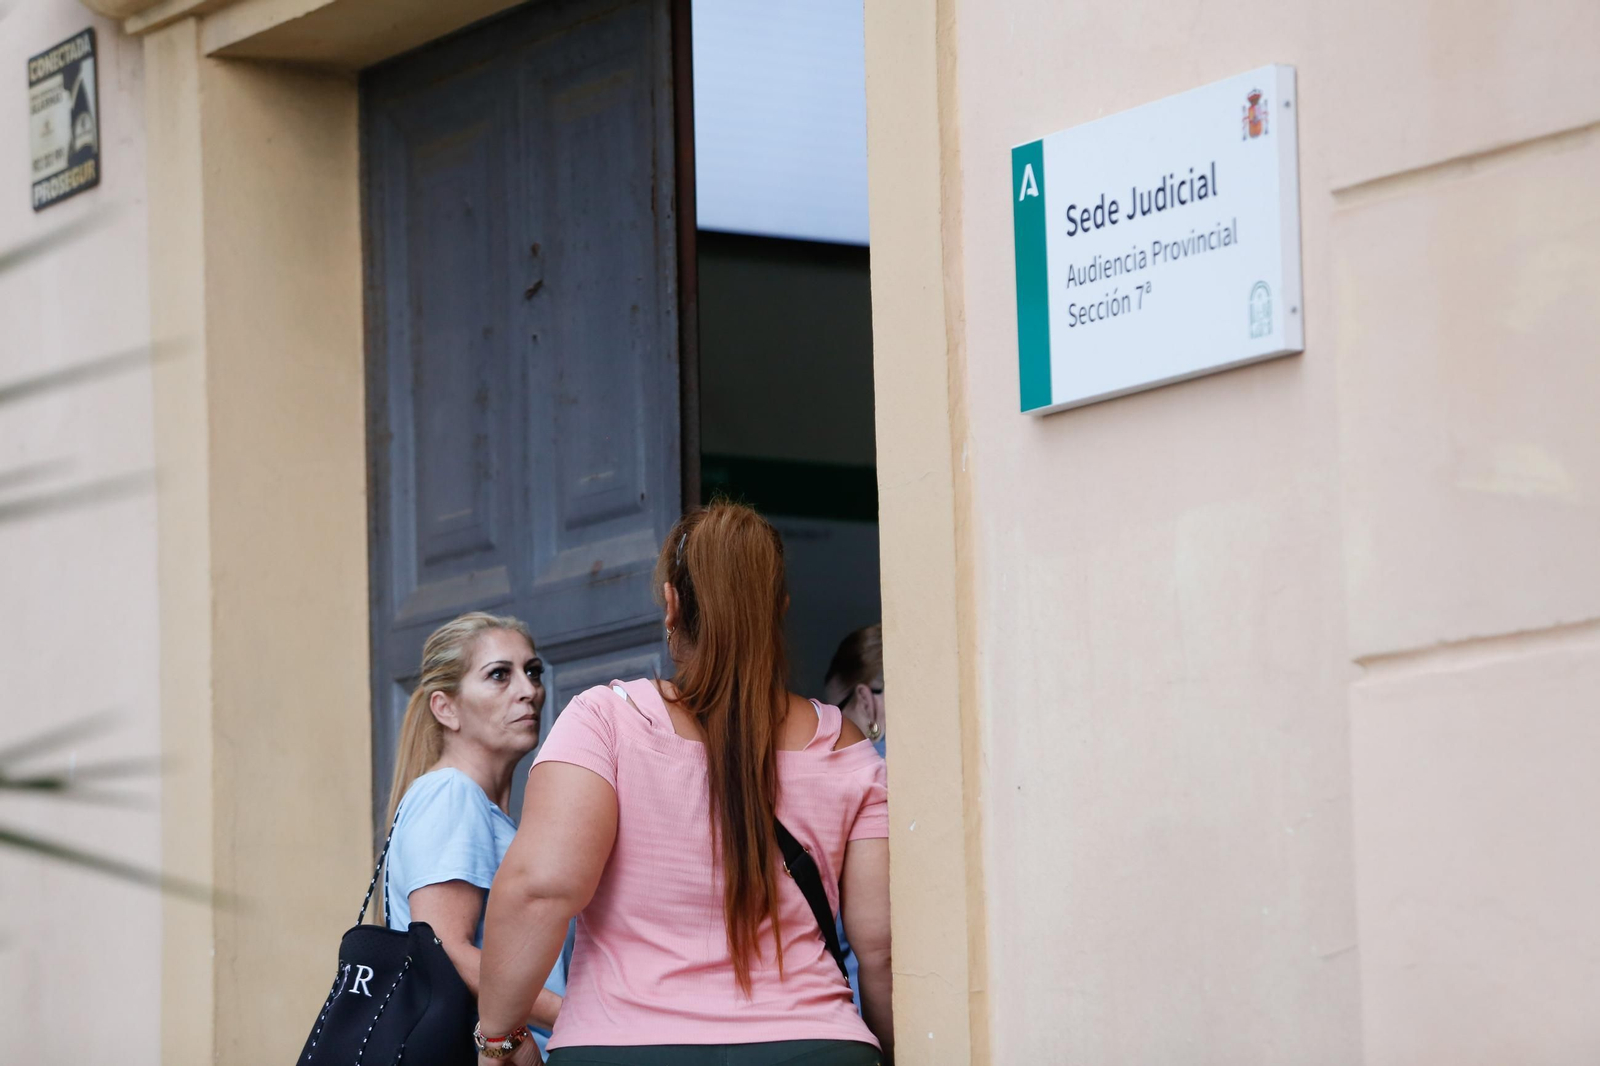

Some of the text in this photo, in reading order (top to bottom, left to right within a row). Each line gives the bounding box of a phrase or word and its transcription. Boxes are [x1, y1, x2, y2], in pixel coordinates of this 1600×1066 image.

[29, 33, 92, 81] CONECTADA
[33, 159, 96, 208] PROSEGUR
[1066, 161, 1218, 237] Sede Judicial
[1066, 217, 1238, 289] Audiencia Provincial
[1068, 288, 1131, 328] Sección
